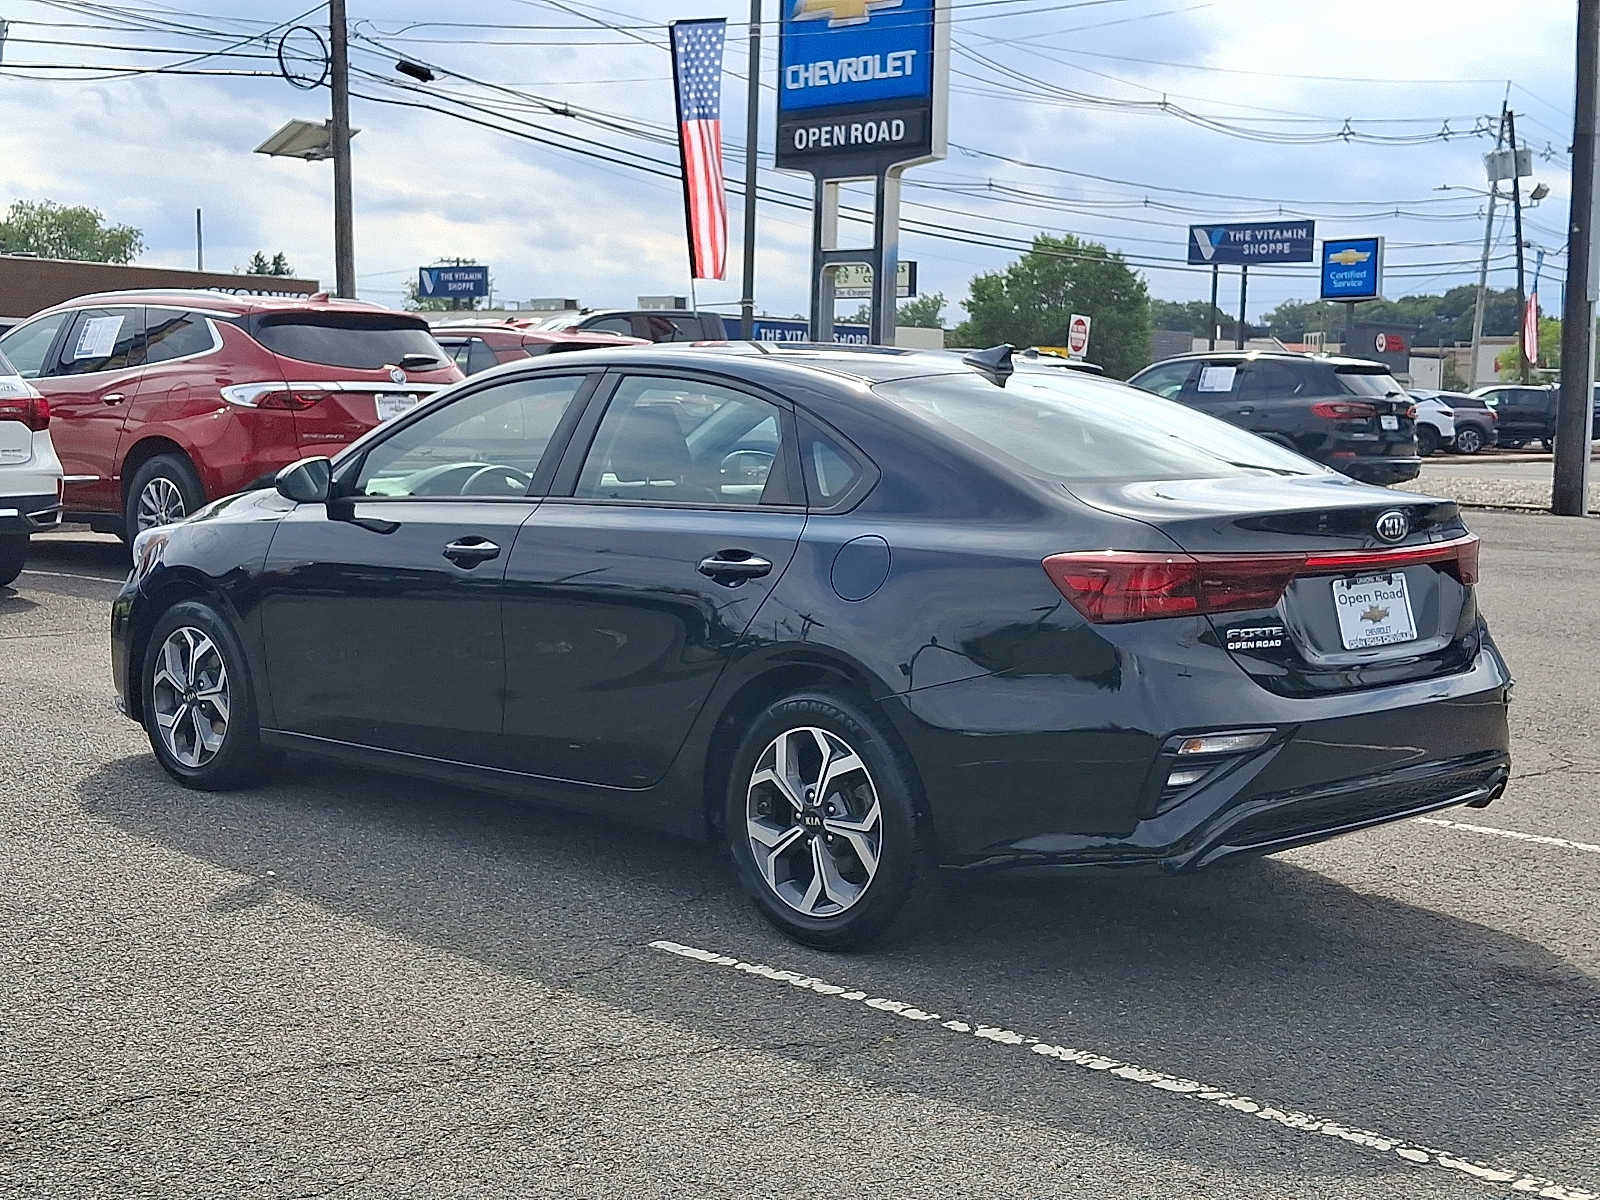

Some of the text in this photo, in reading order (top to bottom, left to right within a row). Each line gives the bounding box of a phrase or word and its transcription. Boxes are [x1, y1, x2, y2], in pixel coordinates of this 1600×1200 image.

[786, 50, 917, 90] CHEVROLET
[794, 119, 905, 150] OPEN ROAD
[1229, 228, 1307, 242] THE VITAMIN
[1242, 242, 1291, 255] SHOPPE
[440, 272, 482, 281] THE VITAMIN
[1329, 270, 1367, 280] Certified
[448, 282, 475, 291] SHOPPE
[1332, 280, 1364, 288] Service
[760, 328, 782, 341] THE
[832, 333, 868, 345] SHOPP
[1384, 517, 1405, 536] KIA
[1338, 589, 1404, 607] Open Road
[1226, 626, 1284, 640] FORTE
[1227, 640, 1282, 650] OPEN ROAD
[804, 816, 821, 826] KIA
